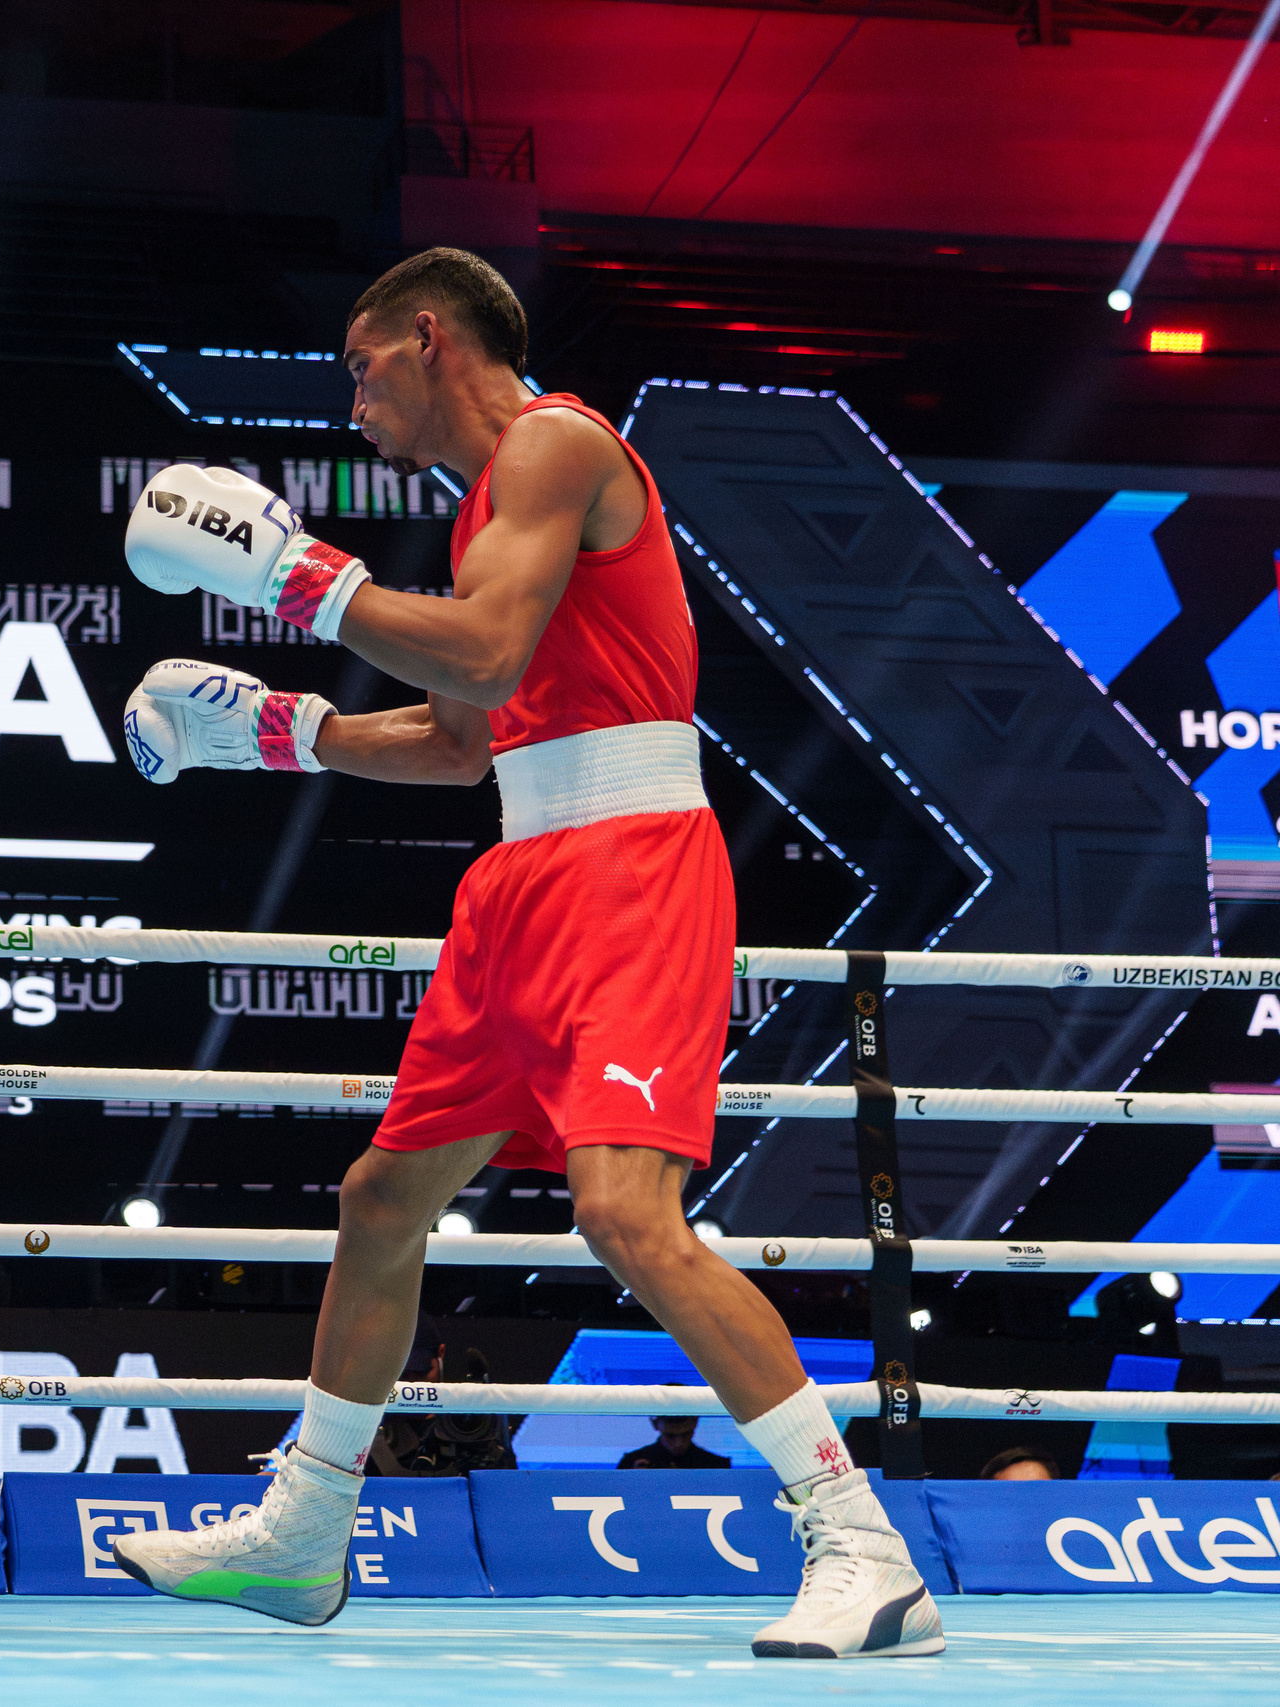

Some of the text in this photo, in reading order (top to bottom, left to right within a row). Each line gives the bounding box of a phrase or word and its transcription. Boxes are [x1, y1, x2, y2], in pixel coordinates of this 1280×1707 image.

[187, 500, 254, 555] IBA
[329, 940, 396, 966] artel
[1113, 968, 1252, 987] UZBEKISTAN
[862, 1019, 876, 1056] OFB
[365, 1080, 397, 1089] GOLD
[365, 1091, 394, 1100] HOU
[725, 1091, 772, 1100] GOLDEN
[724, 1102, 763, 1110] HOUSE
[878, 1202, 895, 1239] OFB
[28, 1381, 67, 1396] OFB
[401, 1386, 438, 1401] OFB
[893, 1388, 909, 1425] OFB
